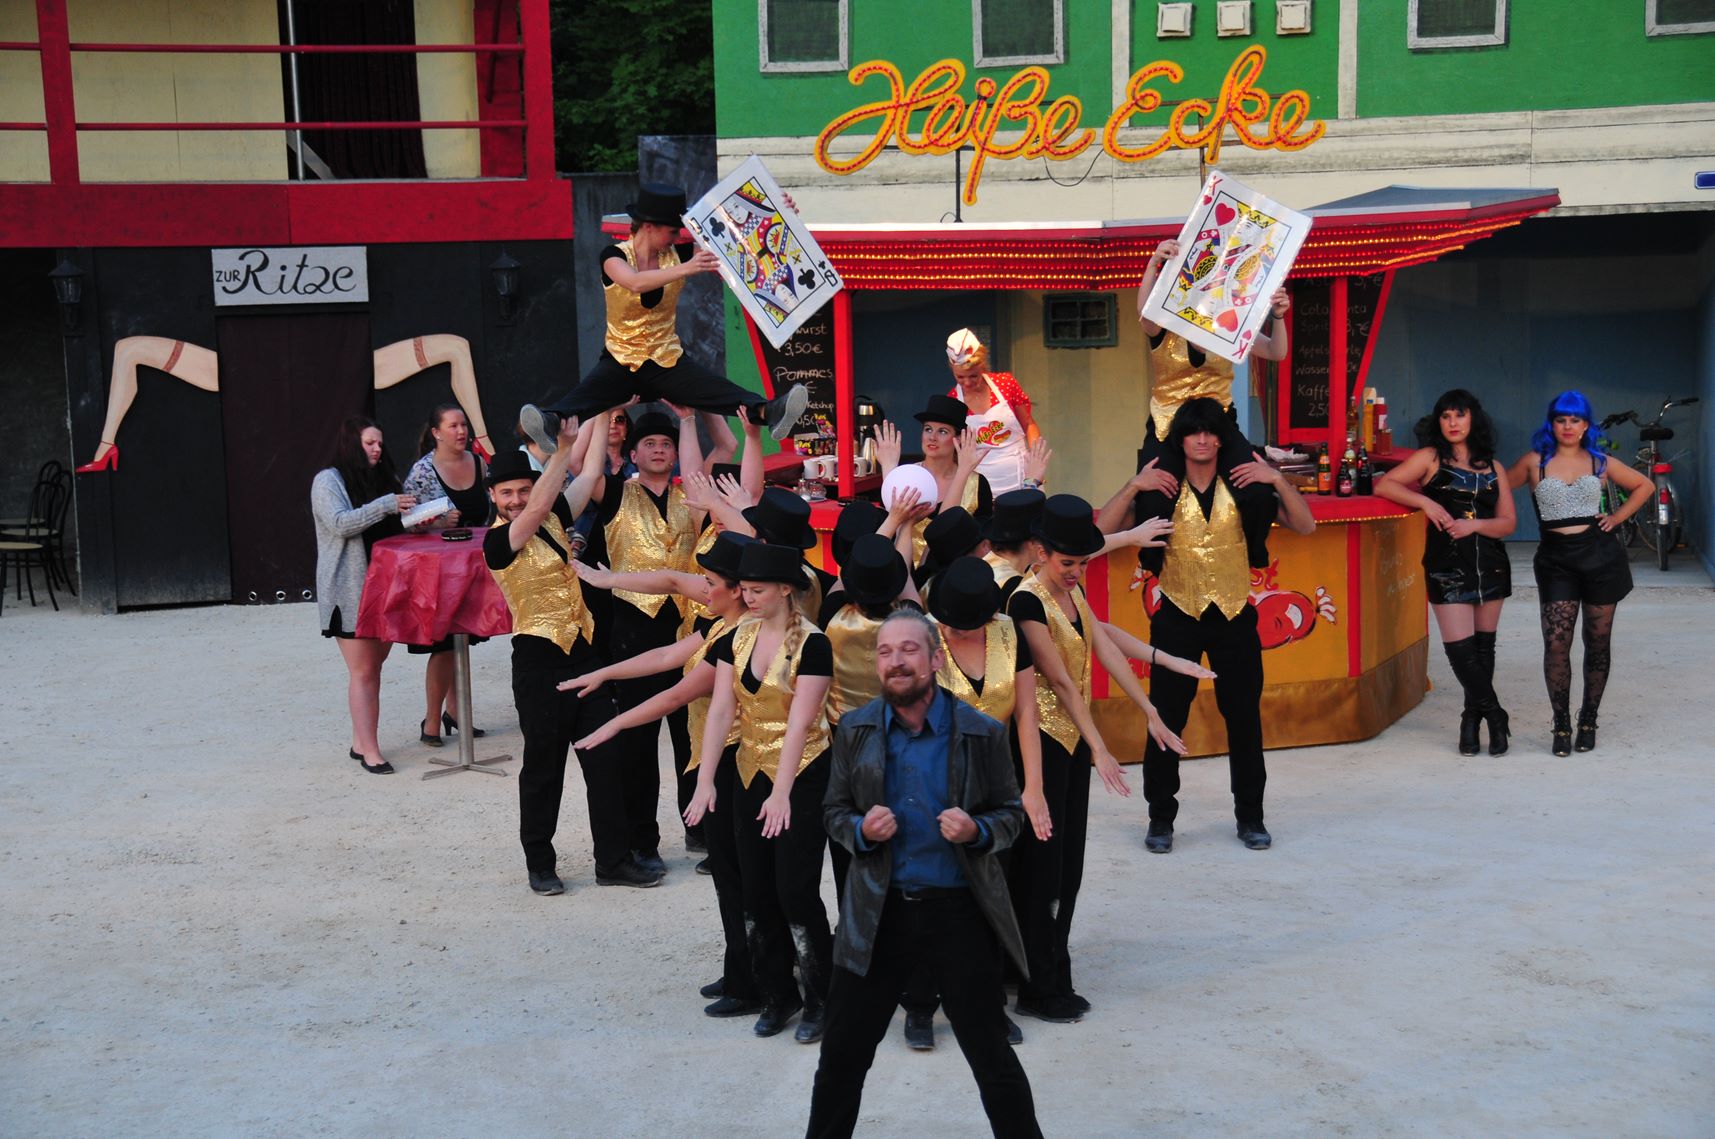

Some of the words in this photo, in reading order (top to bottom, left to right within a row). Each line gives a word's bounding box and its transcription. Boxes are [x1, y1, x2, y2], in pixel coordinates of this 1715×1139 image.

[814, 58, 1096, 206] Heiße
[1103, 43, 1326, 165] Ecke
[215, 269, 242, 283] ZUR
[221, 249, 357, 296] Ritze
[824, 269, 839, 288] Q
[1232, 340, 1249, 360] K
[773, 366, 833, 383] Pommes
[1297, 383, 1330, 401] Kaffe
